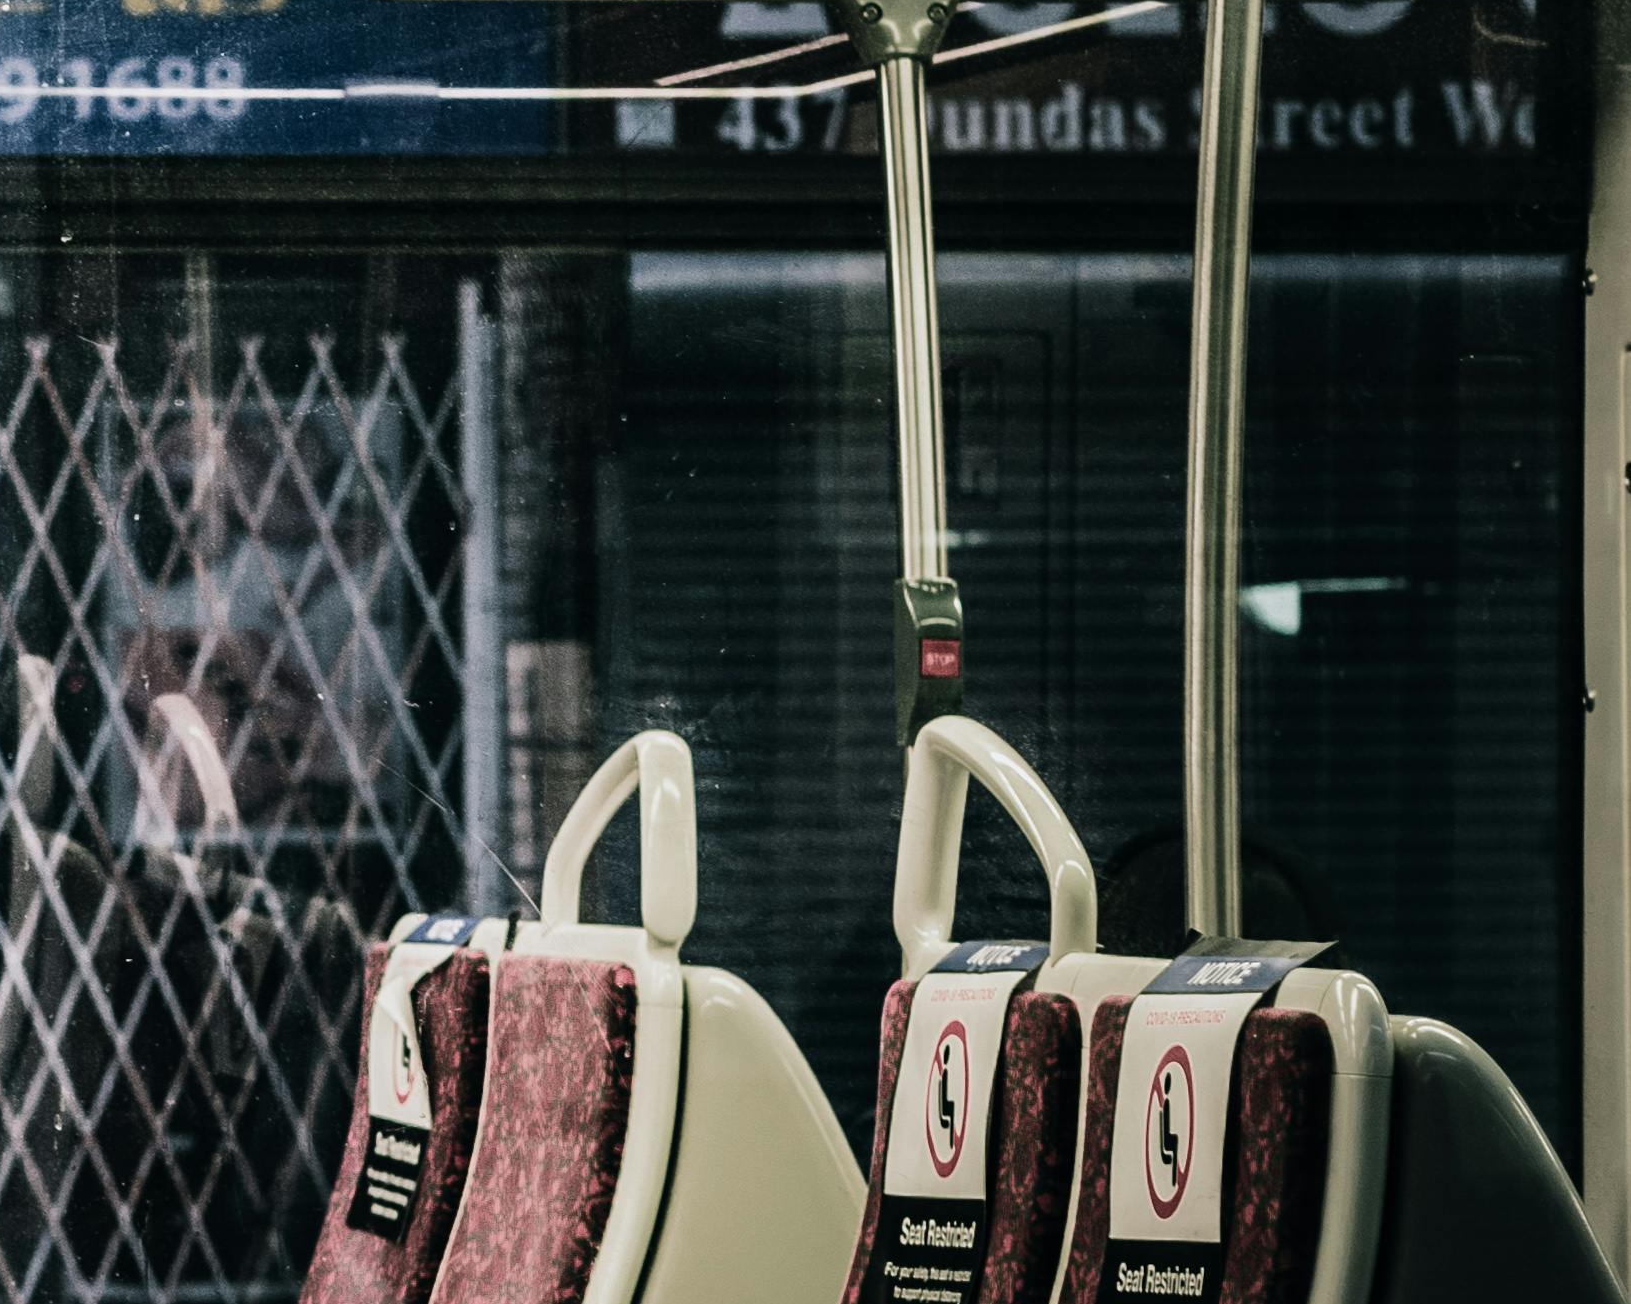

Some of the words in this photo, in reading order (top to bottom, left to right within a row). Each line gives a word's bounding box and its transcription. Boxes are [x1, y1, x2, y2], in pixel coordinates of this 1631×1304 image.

[927, 80, 1168, 154] undas
[1189, 85, 1416, 151] reet
[1186, 961, 1262, 986] NOTICE
[899, 1216, 926, 1246] Seat
[927, 1218, 976, 1249] Restricted
[1116, 1262, 1144, 1293] Seat
[1145, 1263, 1205, 1297] Restricted
